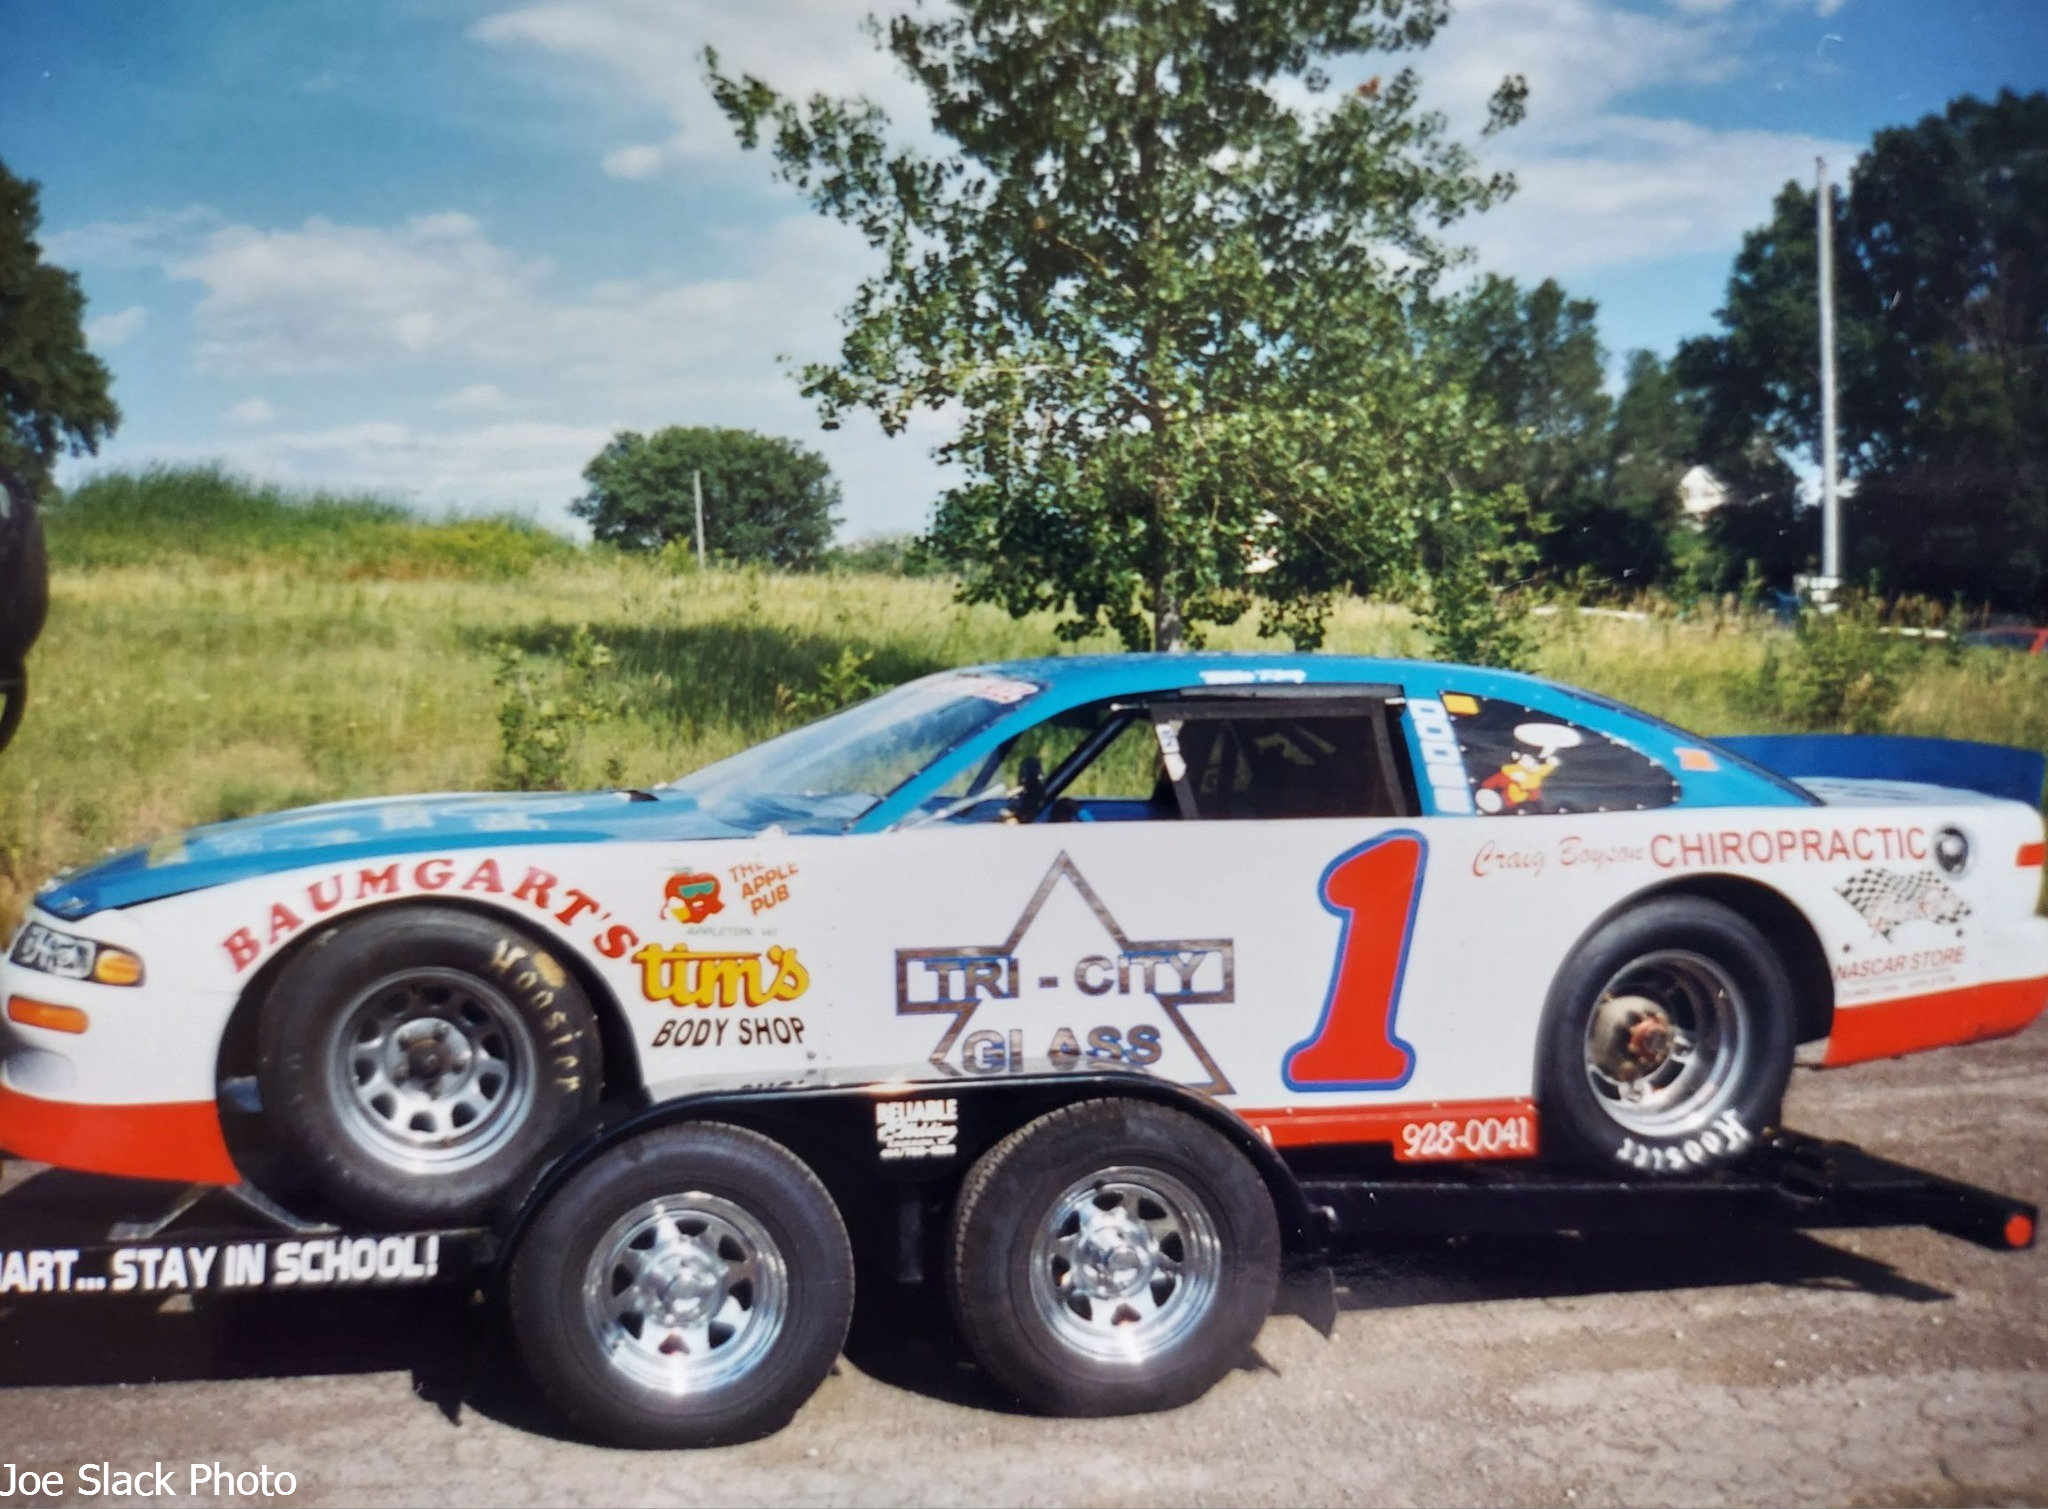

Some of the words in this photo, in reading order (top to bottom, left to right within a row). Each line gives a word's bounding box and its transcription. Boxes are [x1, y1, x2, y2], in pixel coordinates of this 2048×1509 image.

[1650, 827, 1927, 868] CHIROPRACTIC
[728, 862, 764, 882] THE
[741, 863, 799, 900] APPLE
[750, 884, 790, 916] PUB
[926, 959, 1019, 998] TRI
[1073, 951, 1206, 996] CITY
[1282, 829, 1429, 1092] 1
[1836, 955, 1906, 979] NASCAR
[1910, 946, 1966, 970] STORE
[651, 1018, 729, 1047] BODY
[738, 1017, 805, 1045] SHOP
[1402, 1115, 1529, 1156] 928-0041
[111, 1246, 217, 1289] STAY
[225, 1243, 265, 1286] IN
[271, 1234, 439, 1284] SCHOOL!
